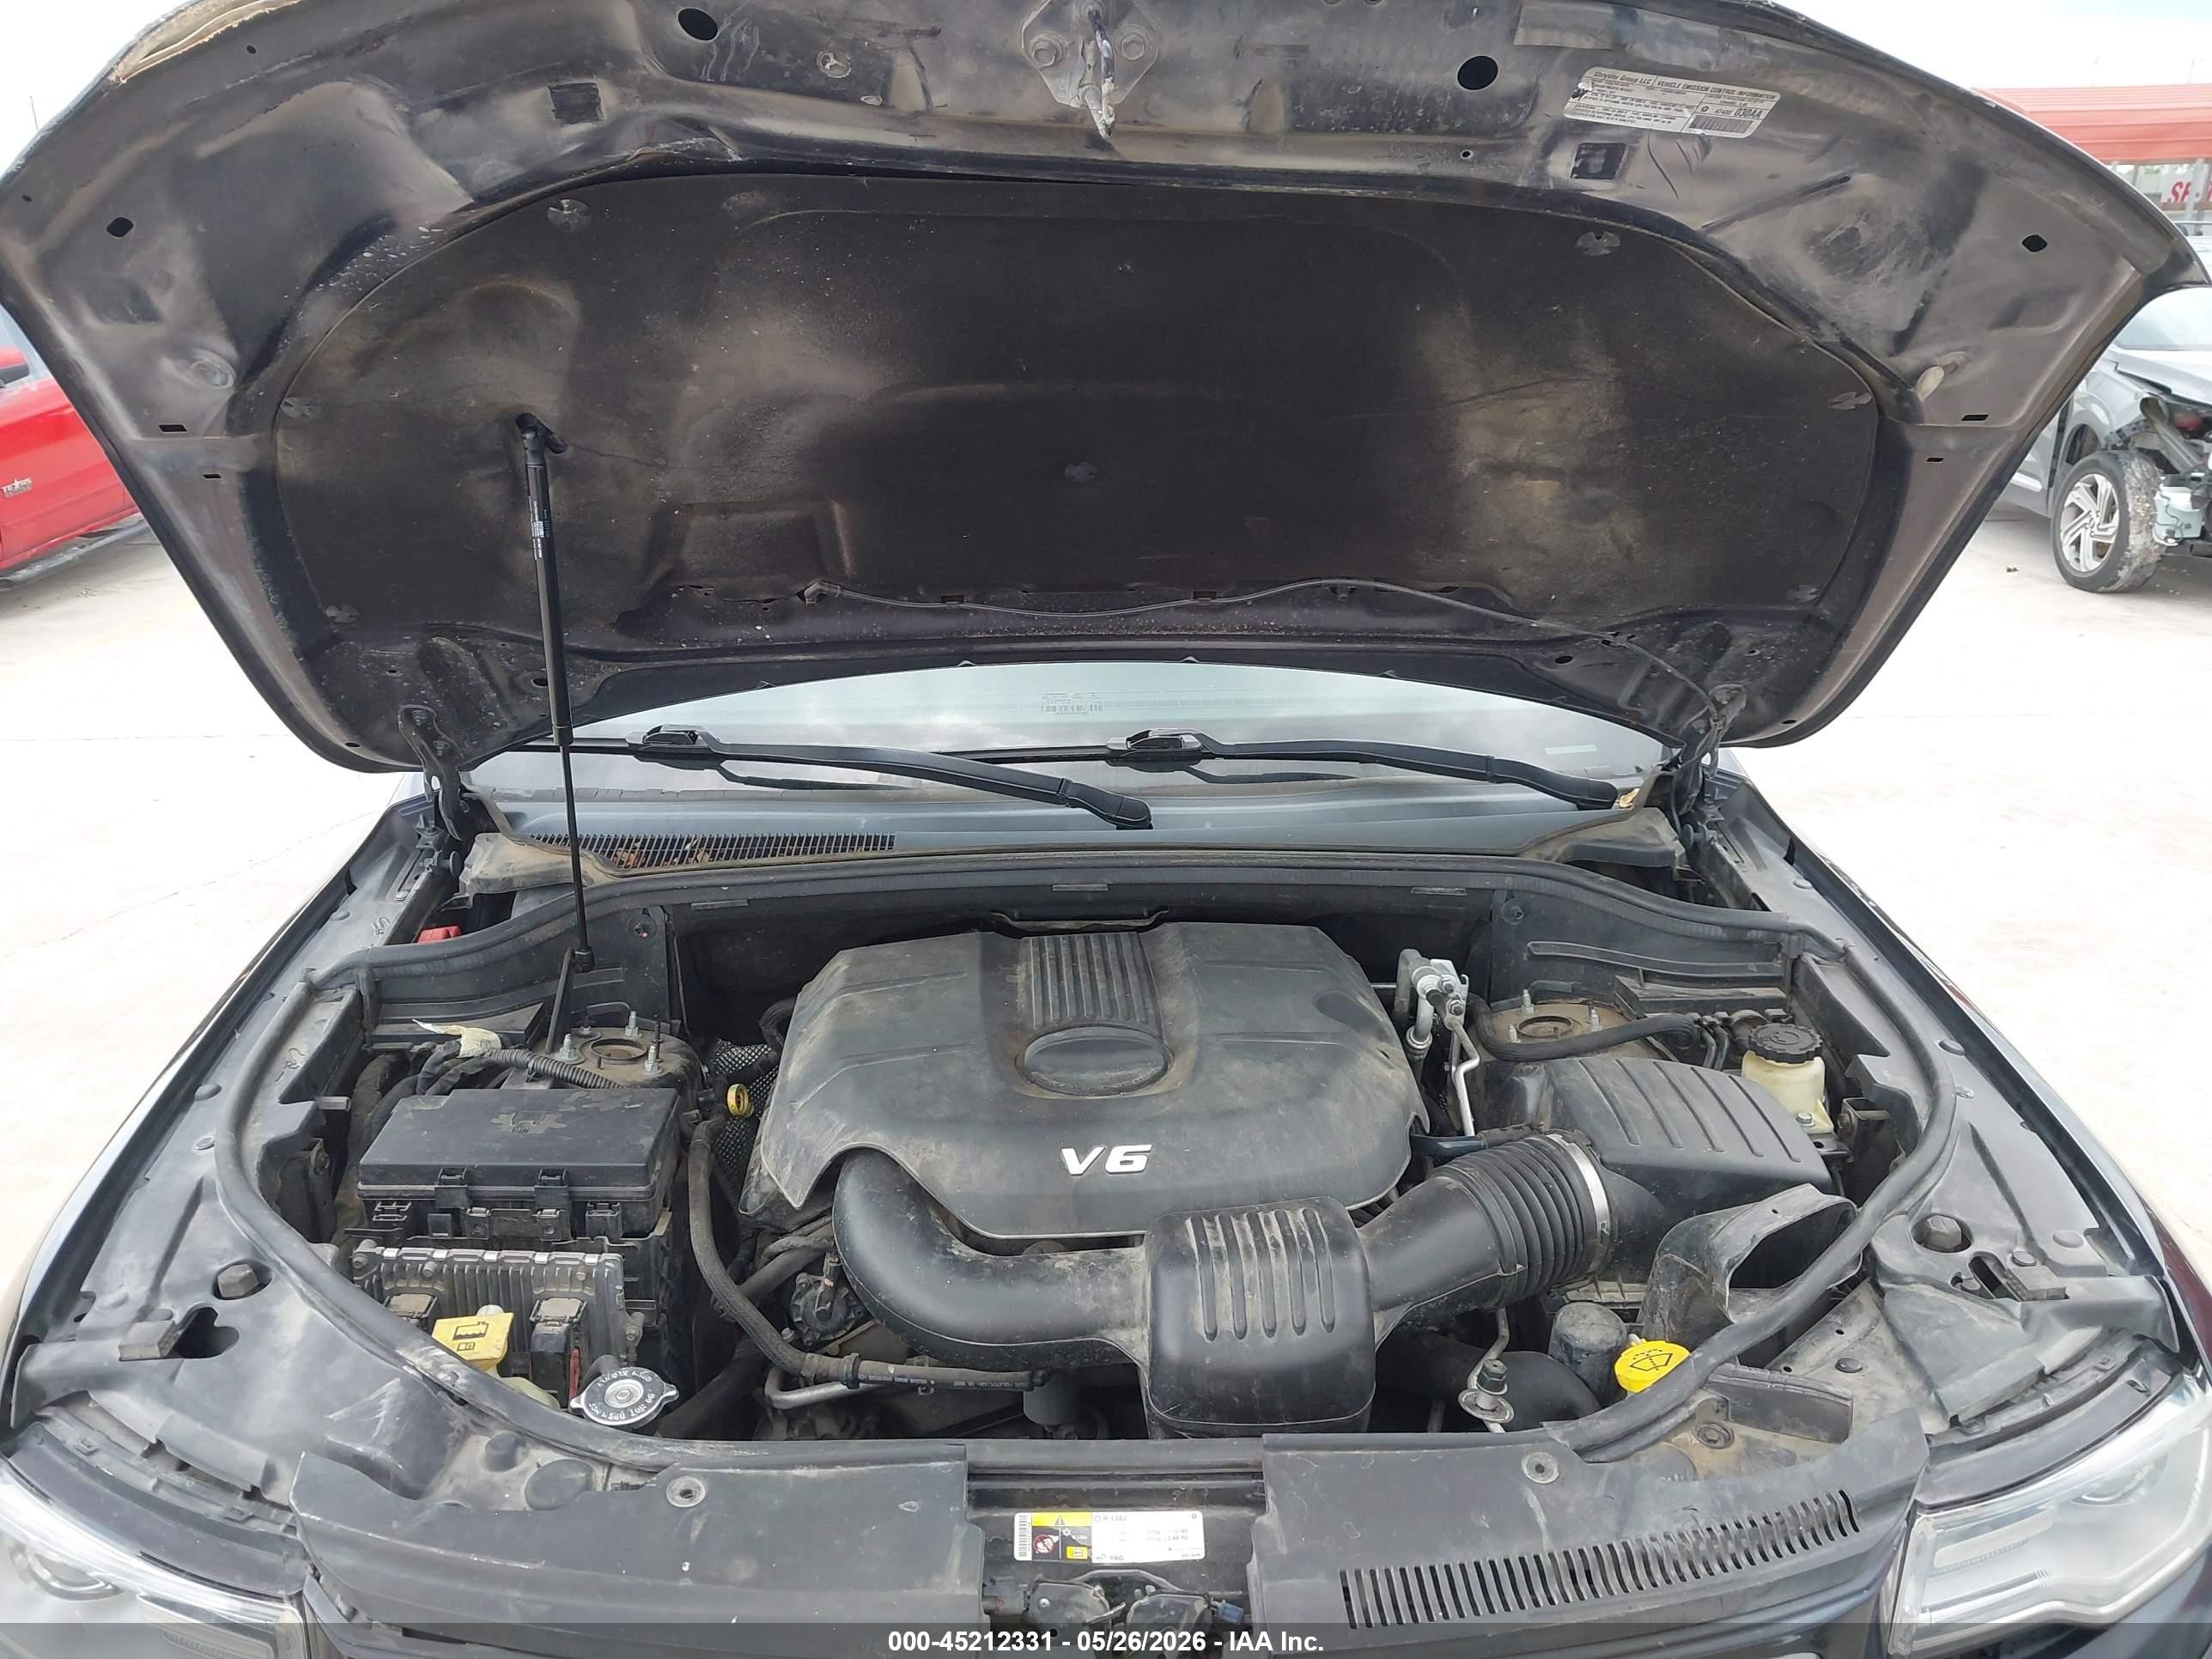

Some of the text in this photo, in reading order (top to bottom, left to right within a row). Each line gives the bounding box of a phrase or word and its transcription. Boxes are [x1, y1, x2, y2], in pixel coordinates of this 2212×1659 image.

[1594, 71, 1620, 80] Chrysler
[1620, 75, 1639, 83] Group
[1681, 83, 1710, 92] EMISSION
[1736, 90, 1776, 100] INFORMATION
[1734, 107, 1763, 118] 030AA
[1060, 1144, 1152, 1176] V6
[630, 1404, 647, 1417] NOT
